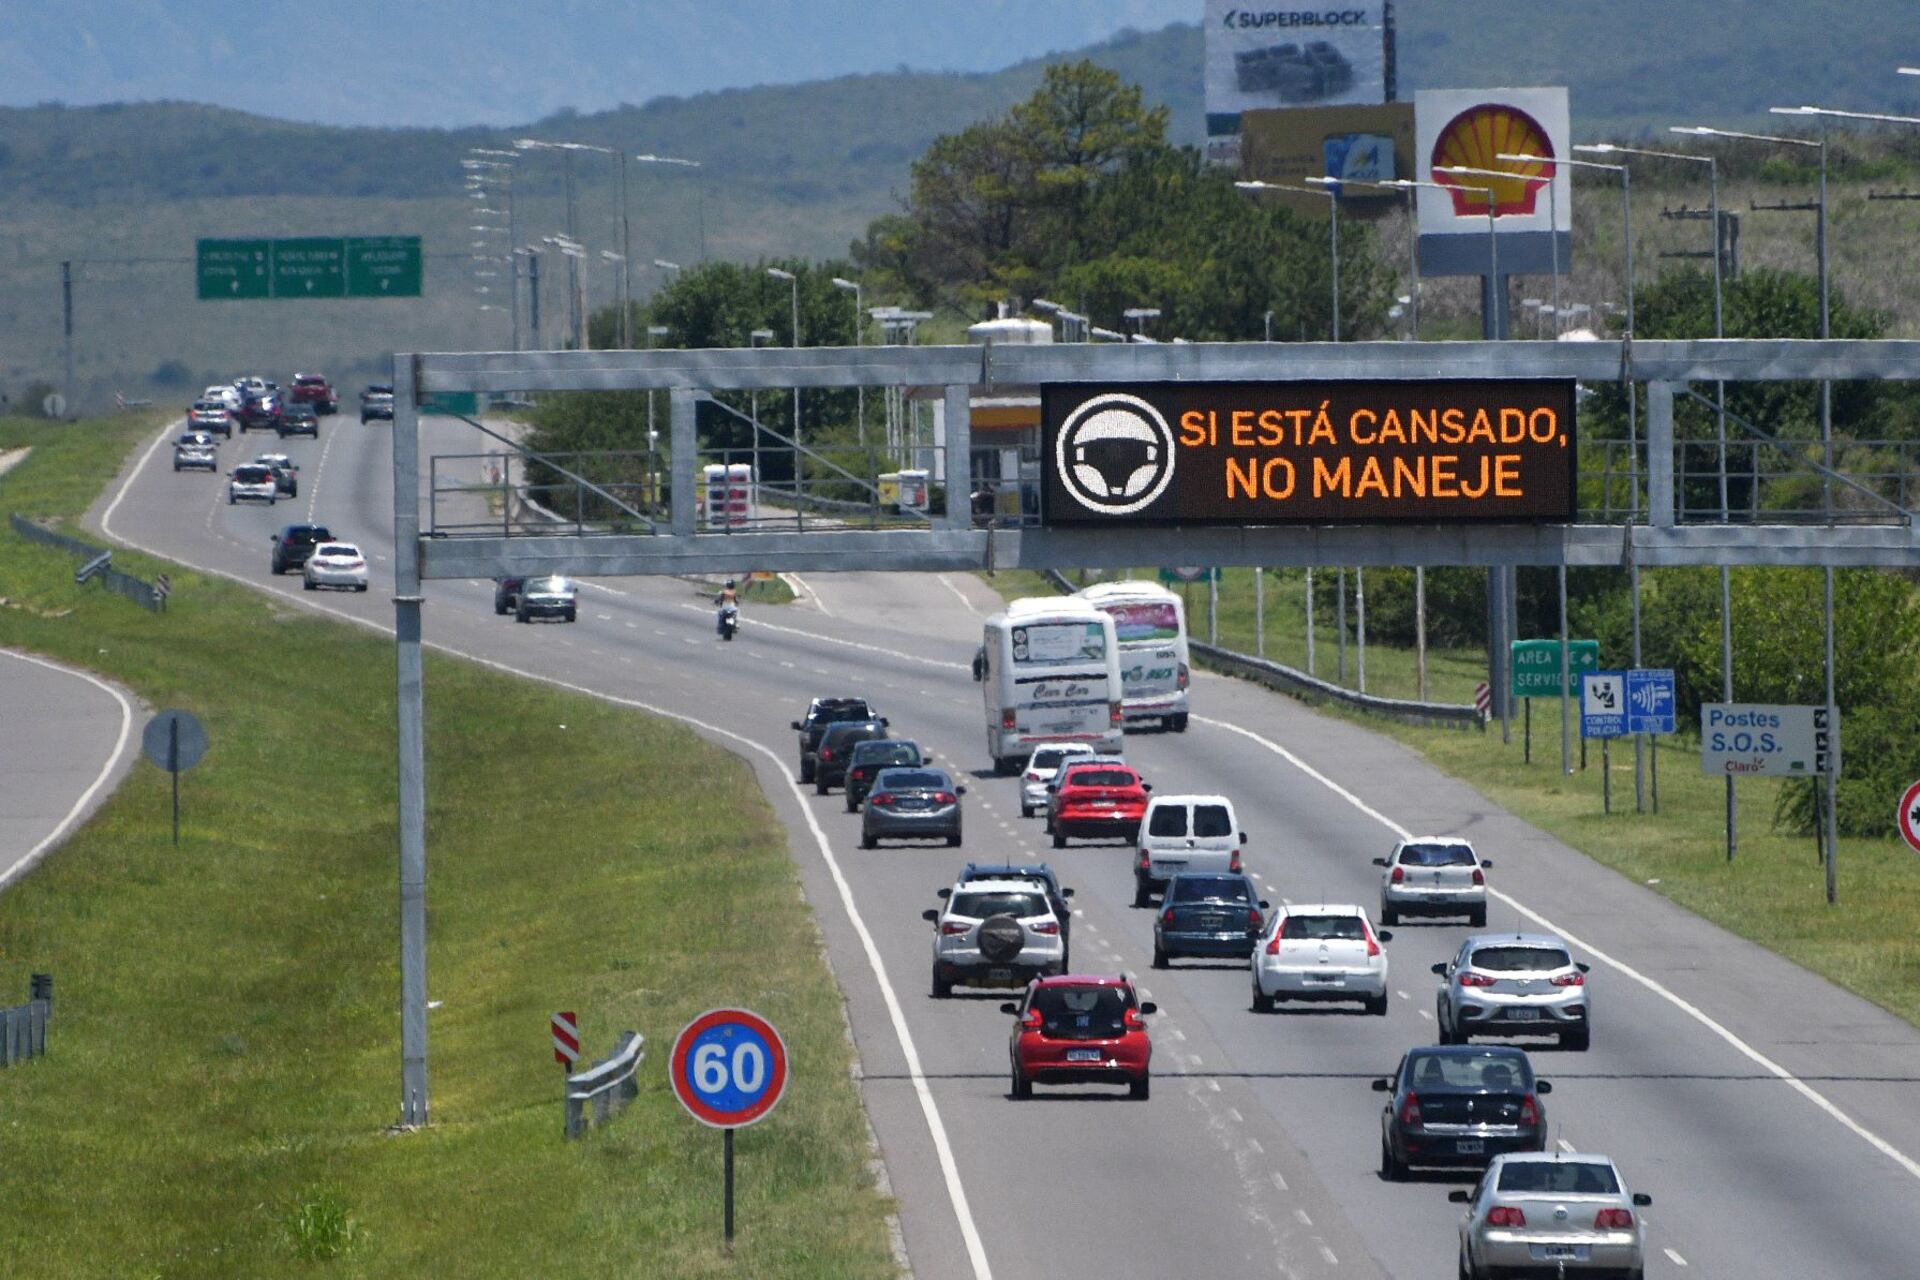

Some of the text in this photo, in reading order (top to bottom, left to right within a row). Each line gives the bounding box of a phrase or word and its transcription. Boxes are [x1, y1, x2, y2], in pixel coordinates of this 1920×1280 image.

[1238, 10, 1366, 28] SUPERBLOCK
[1179, 400, 1568, 448] SI ESTÁ CANSADO,
[1225, 455, 1523, 500] NO MANEJE
[1517, 650, 1552, 664] AREA
[1517, 673, 1578, 687] SERVICO
[1585, 715, 1622, 725] CONTROL
[1709, 709, 1781, 729] Postes
[1710, 732, 1784, 753] S.O.S.
[1725, 759, 1760, 772] Claro
[693, 1042, 765, 1094] 60
